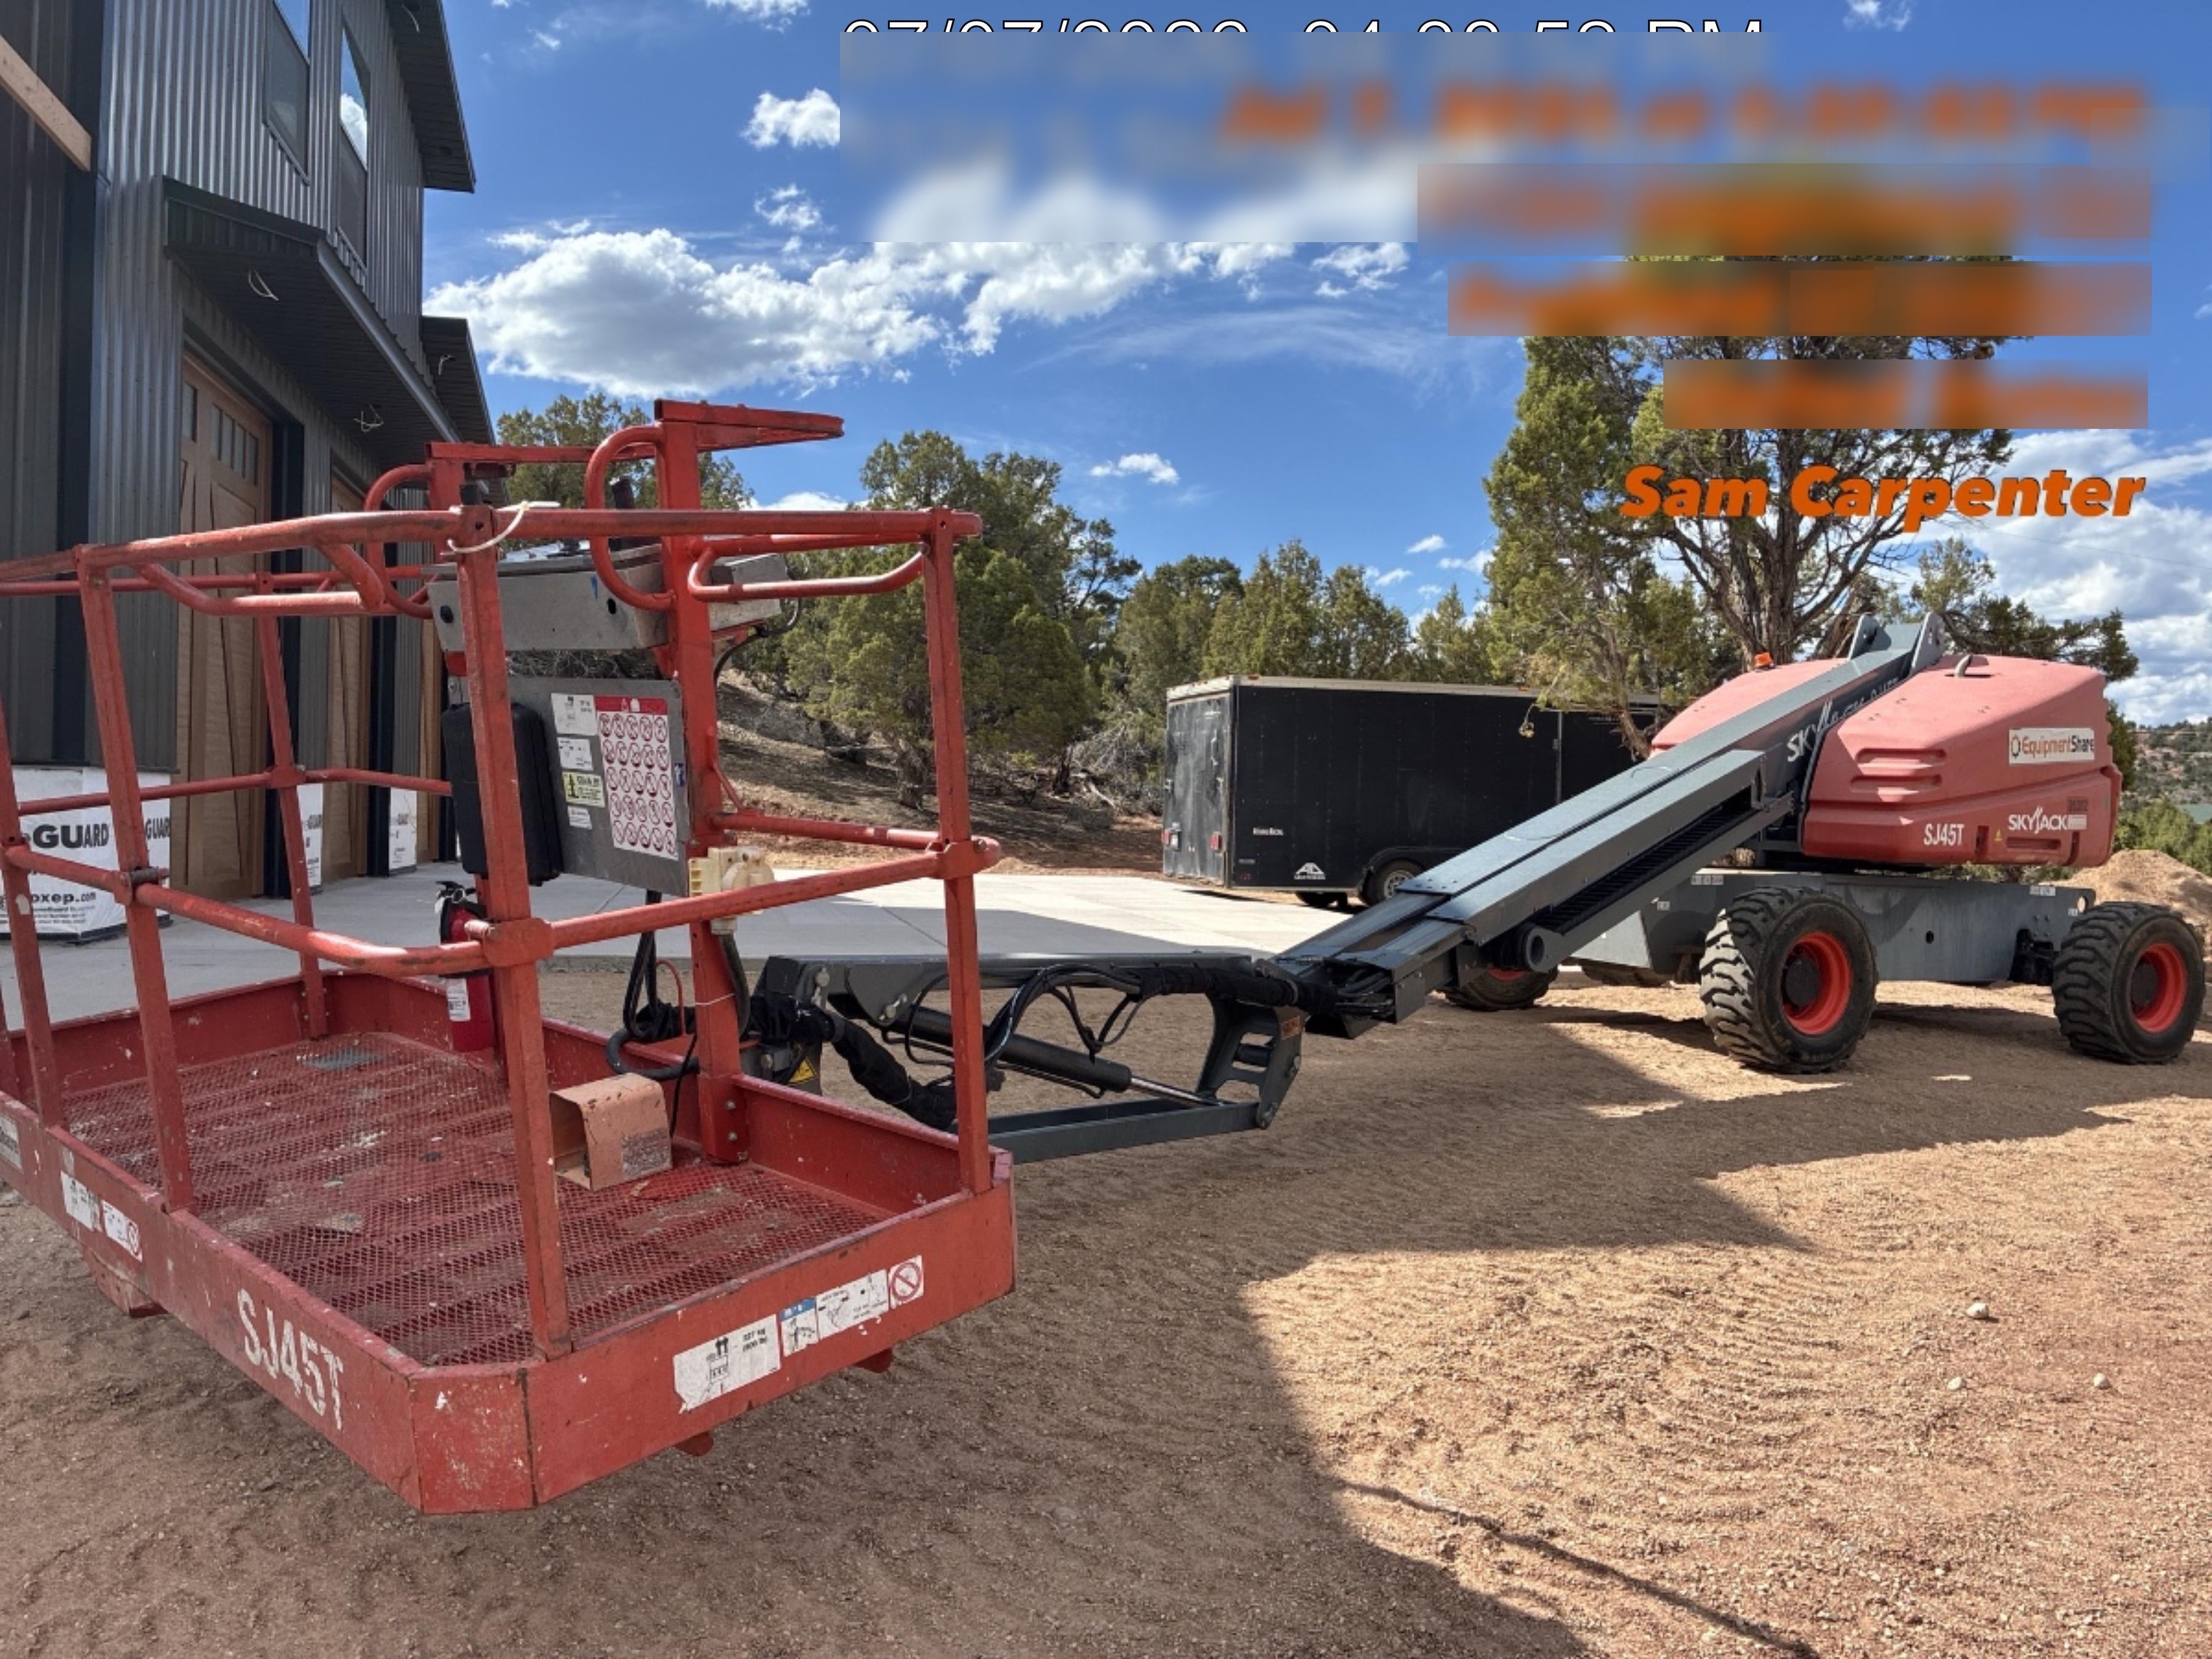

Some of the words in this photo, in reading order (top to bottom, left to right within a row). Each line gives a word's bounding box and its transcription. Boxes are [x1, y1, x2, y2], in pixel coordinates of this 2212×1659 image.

[2022, 735, 2094, 758] EquipmentShare
[2008, 806, 2067, 834] SKYJACK
[1924, 823, 1965, 847] SJ45T
[237, 1288, 344, 1431] SJ45T
